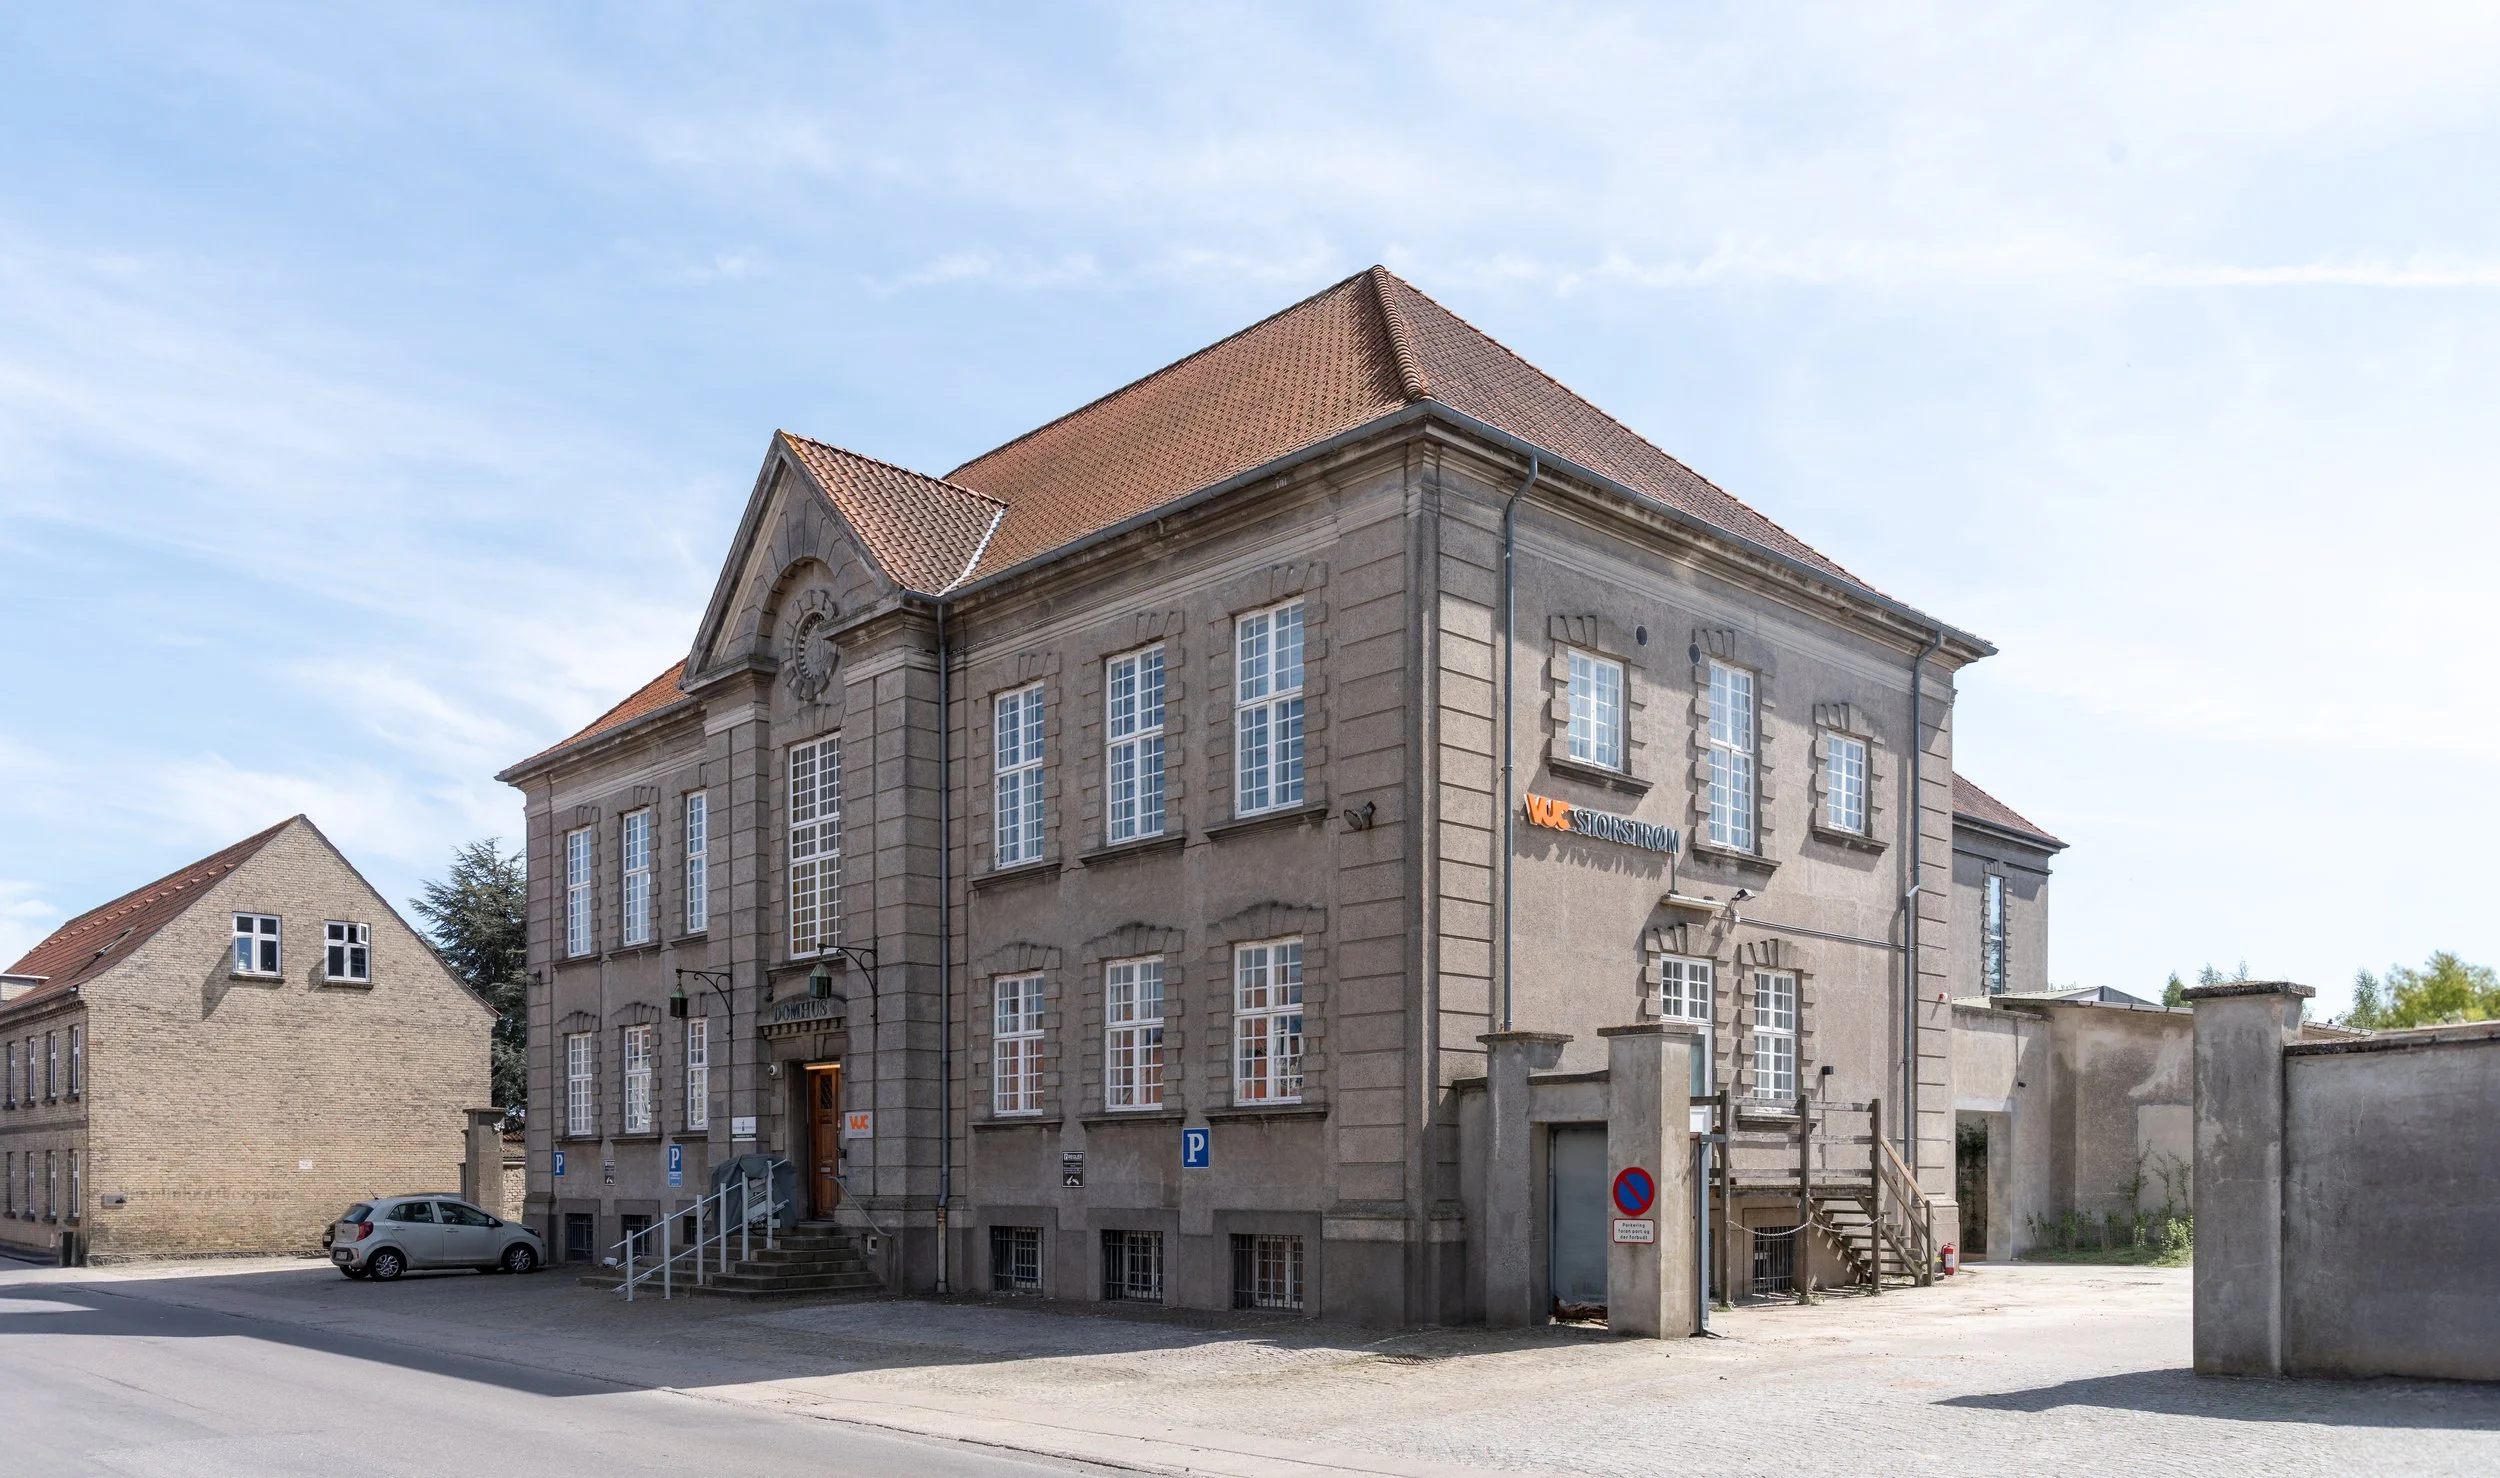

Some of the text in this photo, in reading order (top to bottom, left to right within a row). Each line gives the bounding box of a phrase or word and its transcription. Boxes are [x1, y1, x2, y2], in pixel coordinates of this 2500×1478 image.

[1525, 792, 1680, 855] VUC STORSTRØM
[775, 1000, 828, 1022] DOMHUS
[849, 1115, 869, 1130] VUC
[671, 1148, 680, 1168] P
[1187, 1133, 1205, 1163] P
[556, 1154, 563, 1173] P
